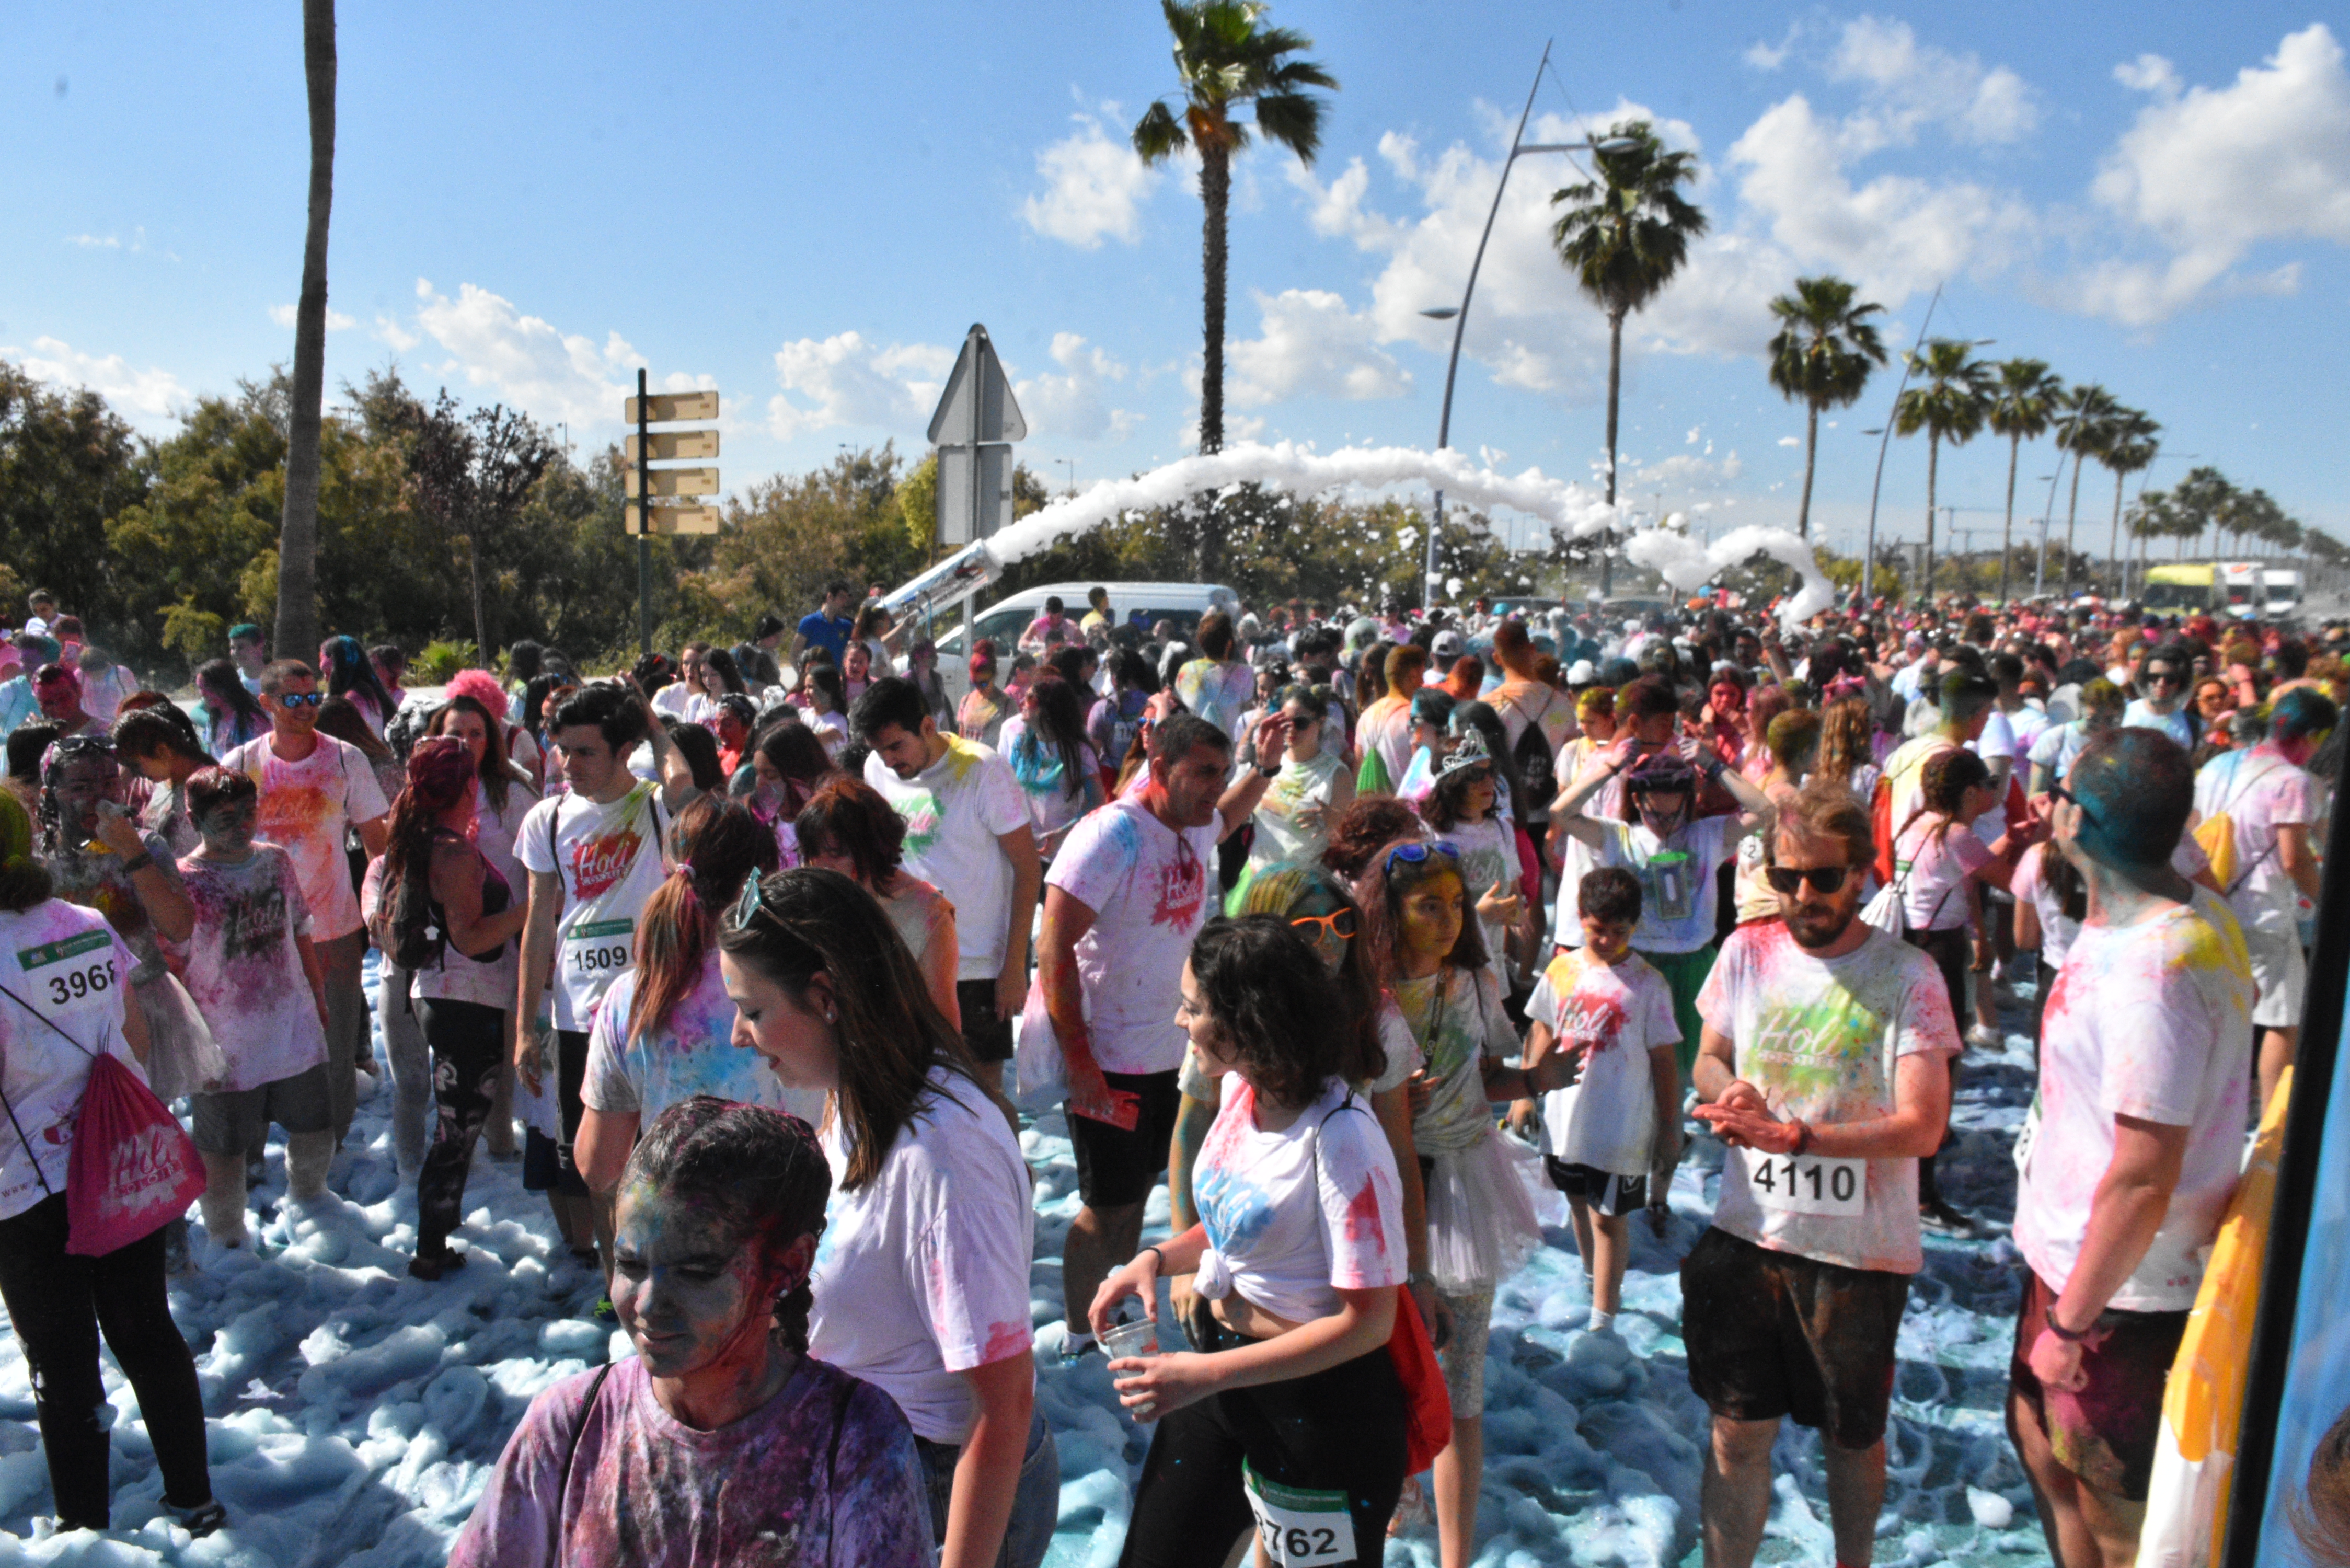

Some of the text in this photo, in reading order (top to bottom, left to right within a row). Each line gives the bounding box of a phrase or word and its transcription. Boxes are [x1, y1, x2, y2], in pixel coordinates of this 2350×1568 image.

[579, 839, 630, 881] Holi
[575, 946, 627, 971] 1509
[1553, 998, 1613, 1039] Holi
[1757, 1009, 1849, 1055] Holi
[113, 1130, 172, 1190] Holi
[1754, 1158, 1856, 1202] 4110
